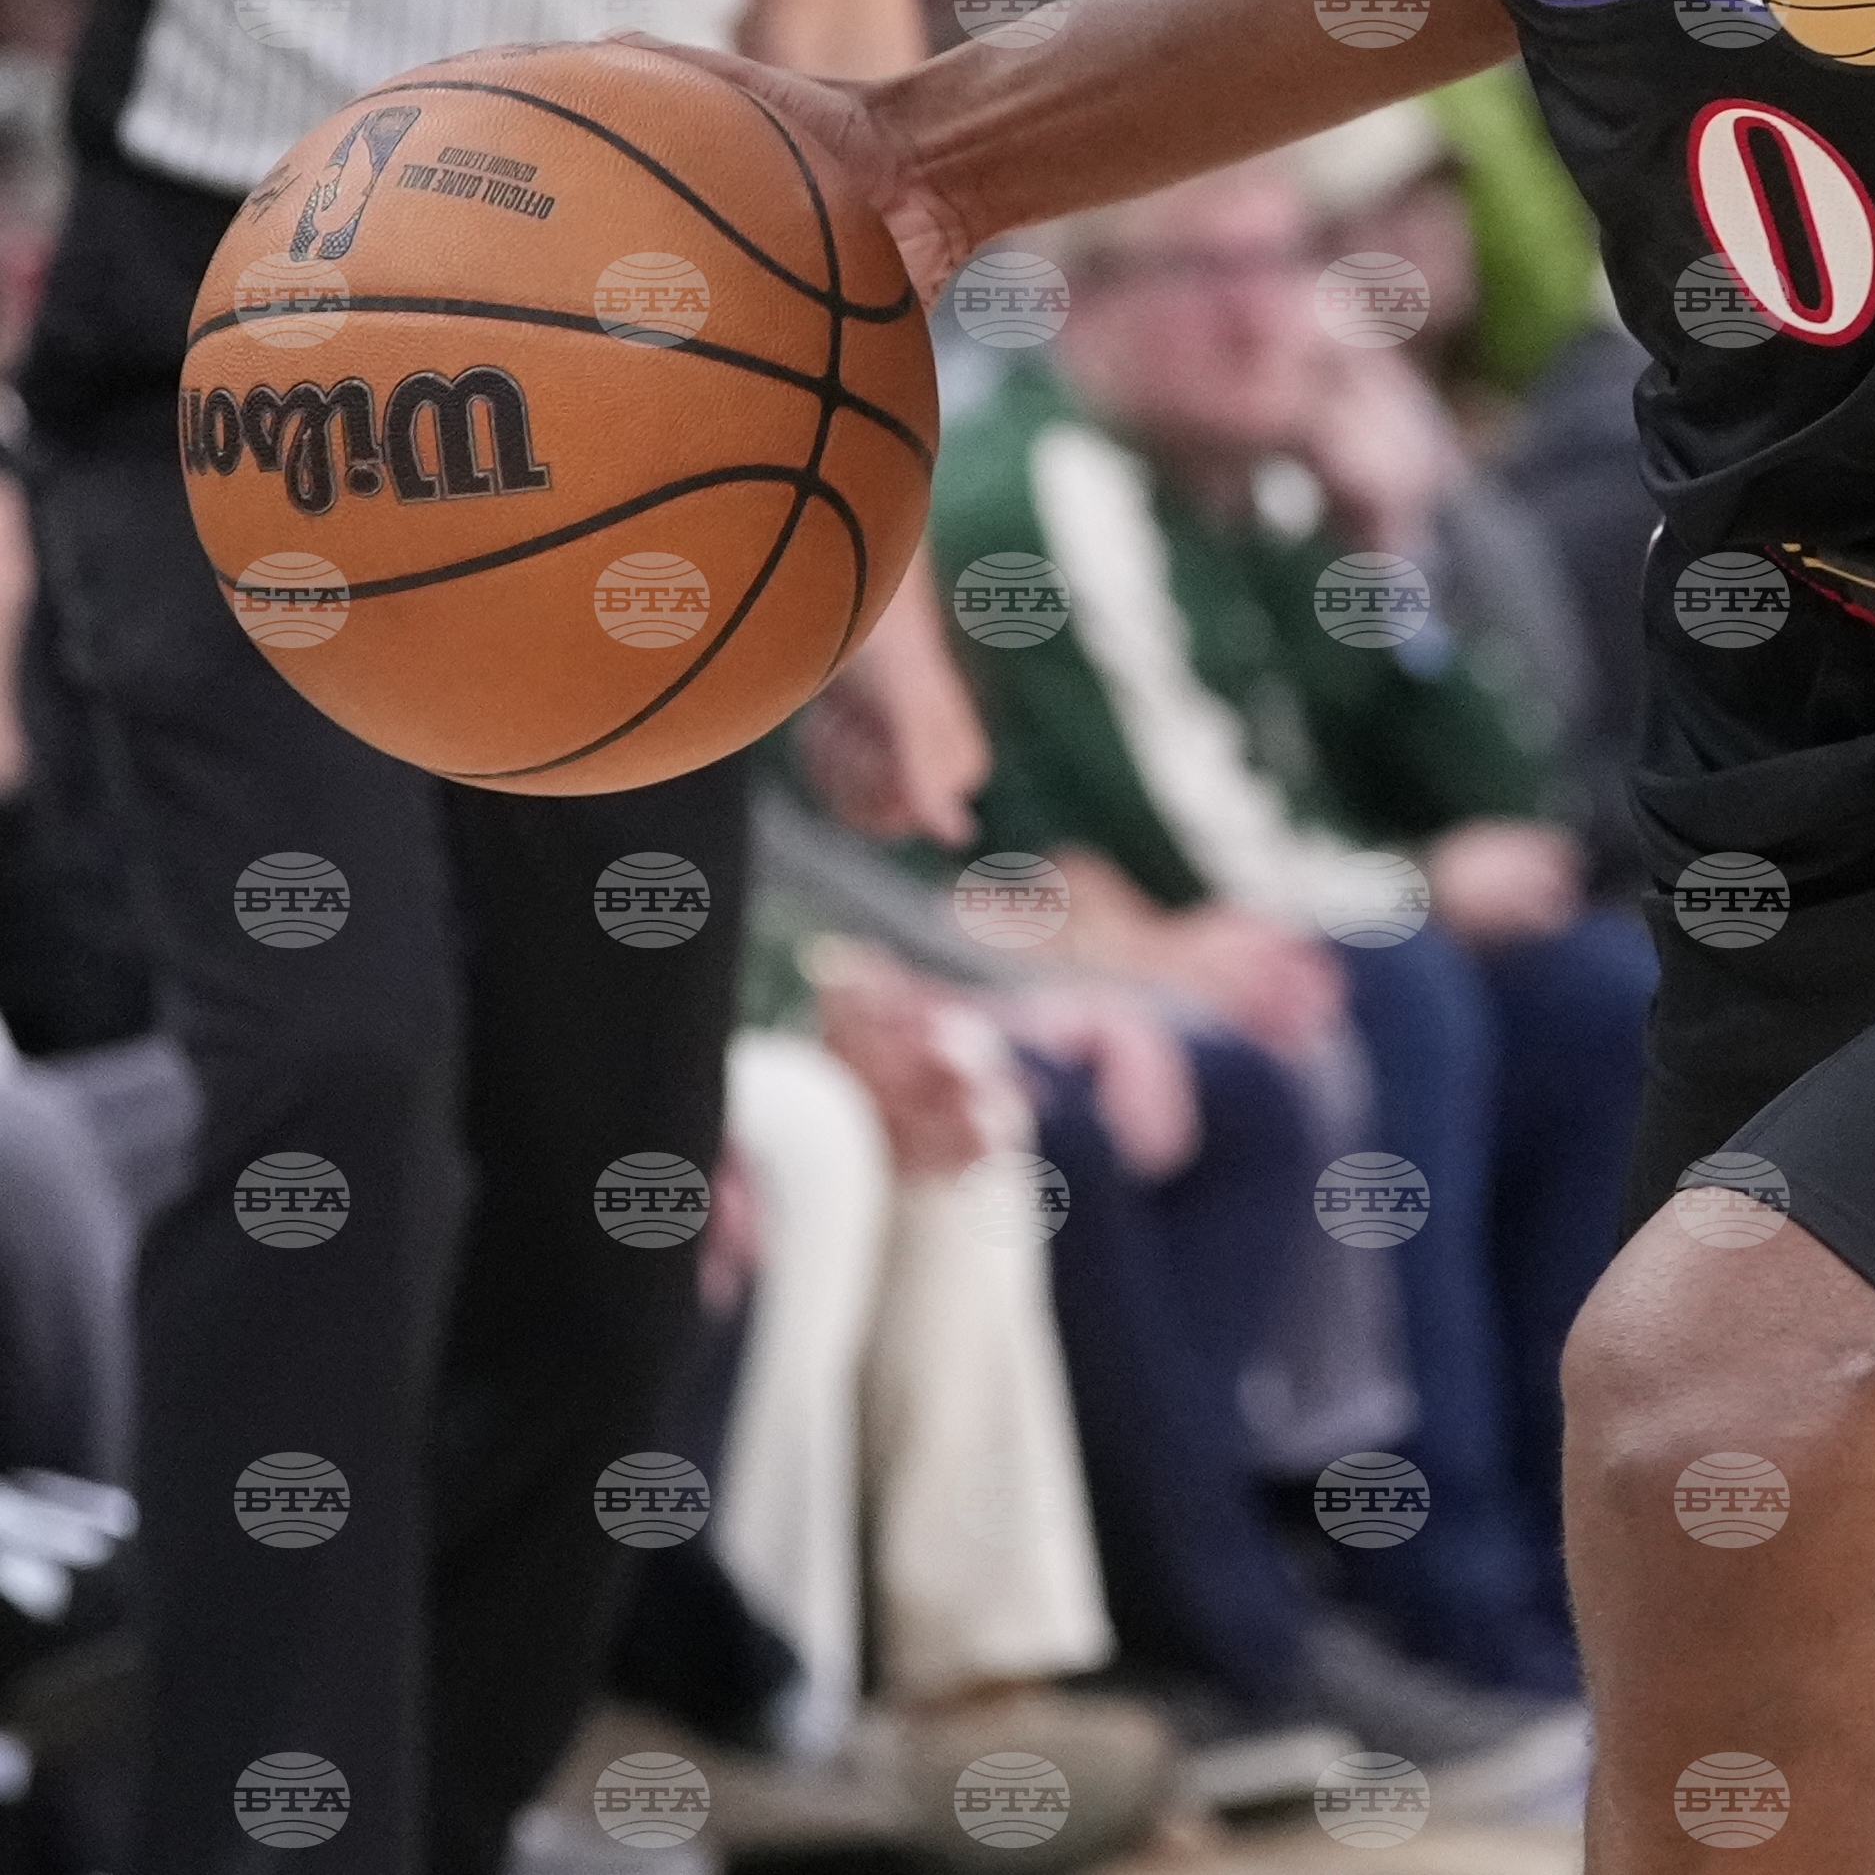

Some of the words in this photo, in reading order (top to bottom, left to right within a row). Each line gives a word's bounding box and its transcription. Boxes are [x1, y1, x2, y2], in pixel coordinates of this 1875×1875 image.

[396, 164, 438, 192] BALL
[431, 168, 483, 200] GAME
[480, 179, 555, 221] OFFICIAL
[181, 365, 551, 517] Wilson
